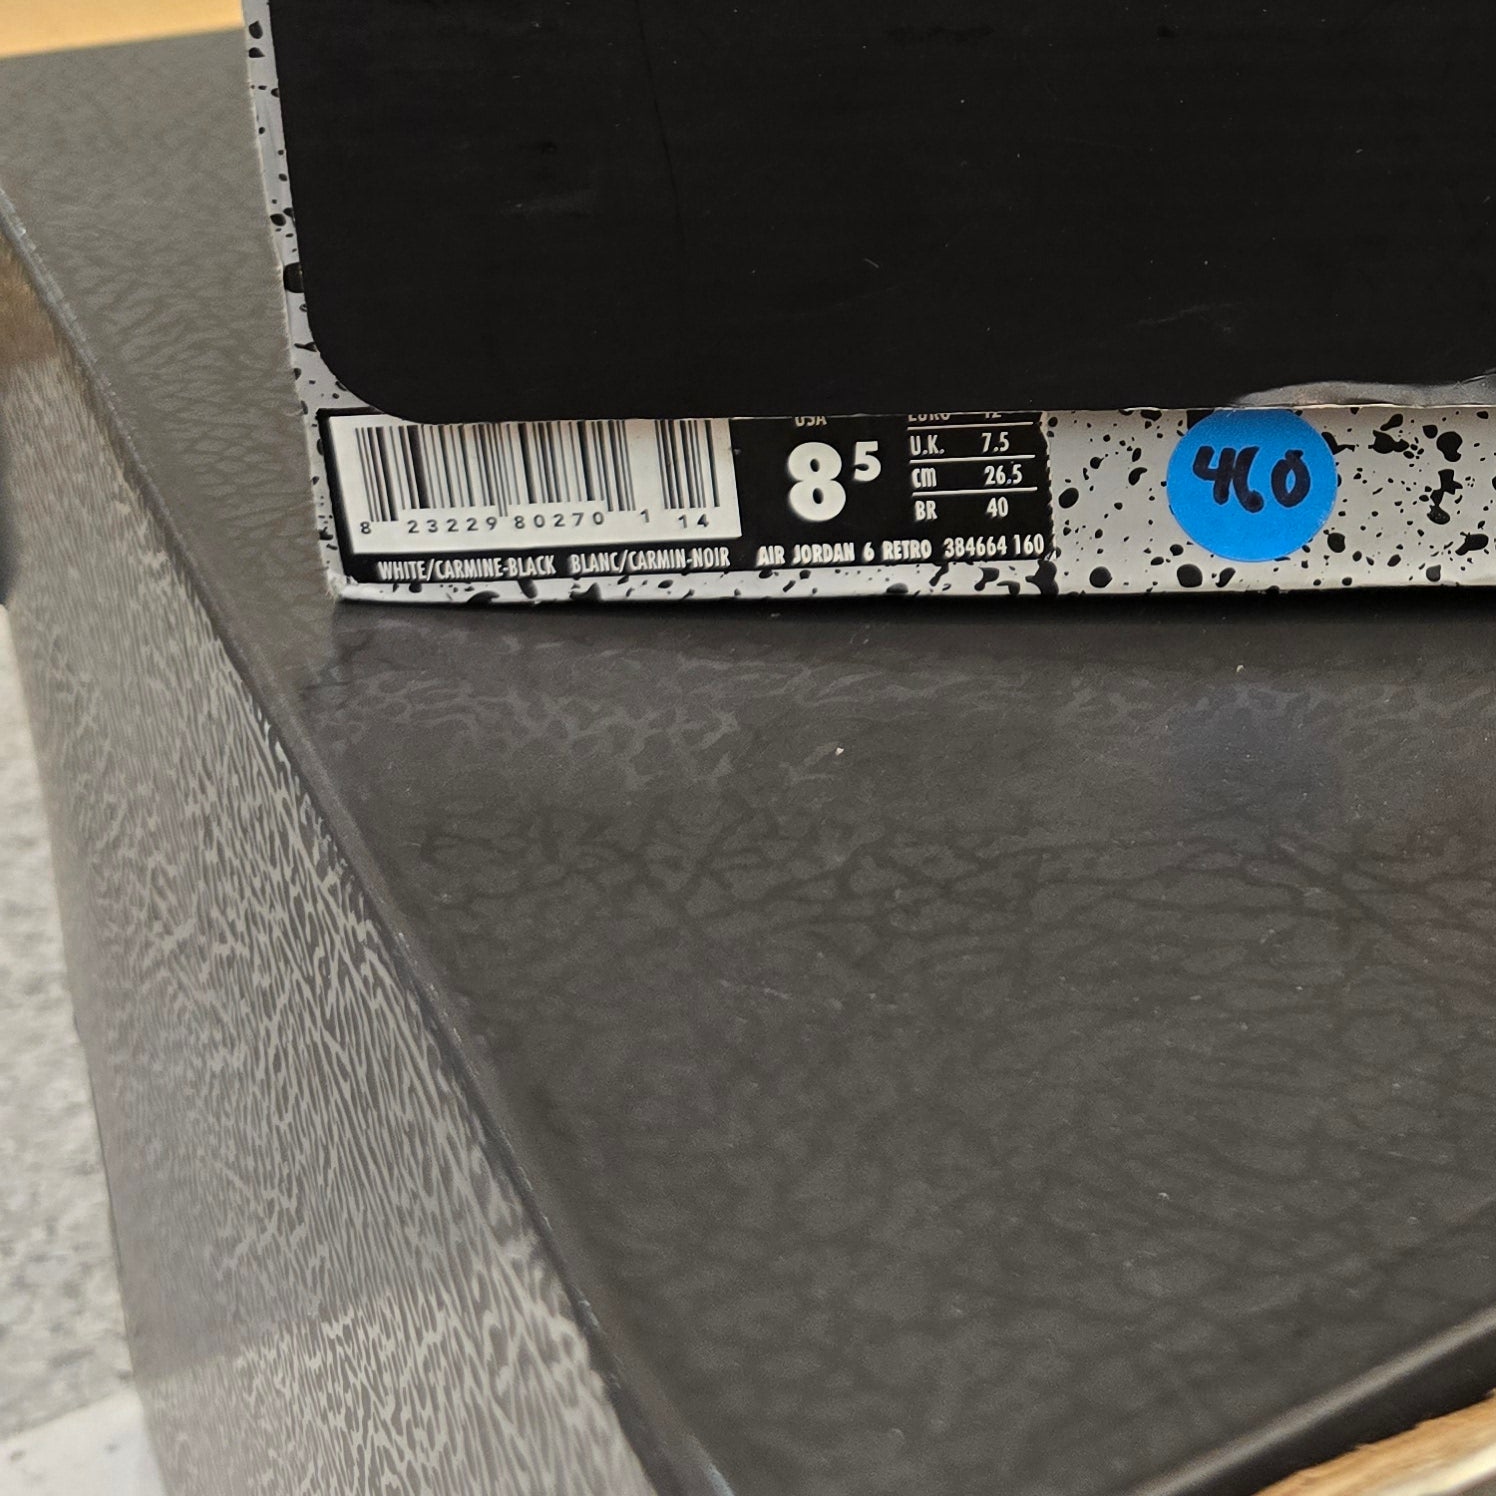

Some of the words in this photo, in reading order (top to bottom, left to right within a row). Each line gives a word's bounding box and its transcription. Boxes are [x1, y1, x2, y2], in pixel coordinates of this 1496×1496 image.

[909, 434, 945, 456] U.K.
[981, 431, 1010, 454] 7.5
[984, 464, 1023, 486] 26.5
[914, 500, 938, 522] BR
[986, 496, 1009, 518] 40
[360, 521, 372, 534] 8
[678, 513, 710, 529] 14
[756, 545, 785, 567] AIR
[792, 542, 855, 565] JORDAN
[863, 542, 875, 562] 6
[881, 539, 932, 561] RETRO
[943, 535, 1008, 558] 384664
[1014, 533, 1045, 555] 160
[377, 554, 557, 581] WHITE/CARMINE-BLACK
[569, 547, 731, 575] BLANC/CARMIN-NOIR
